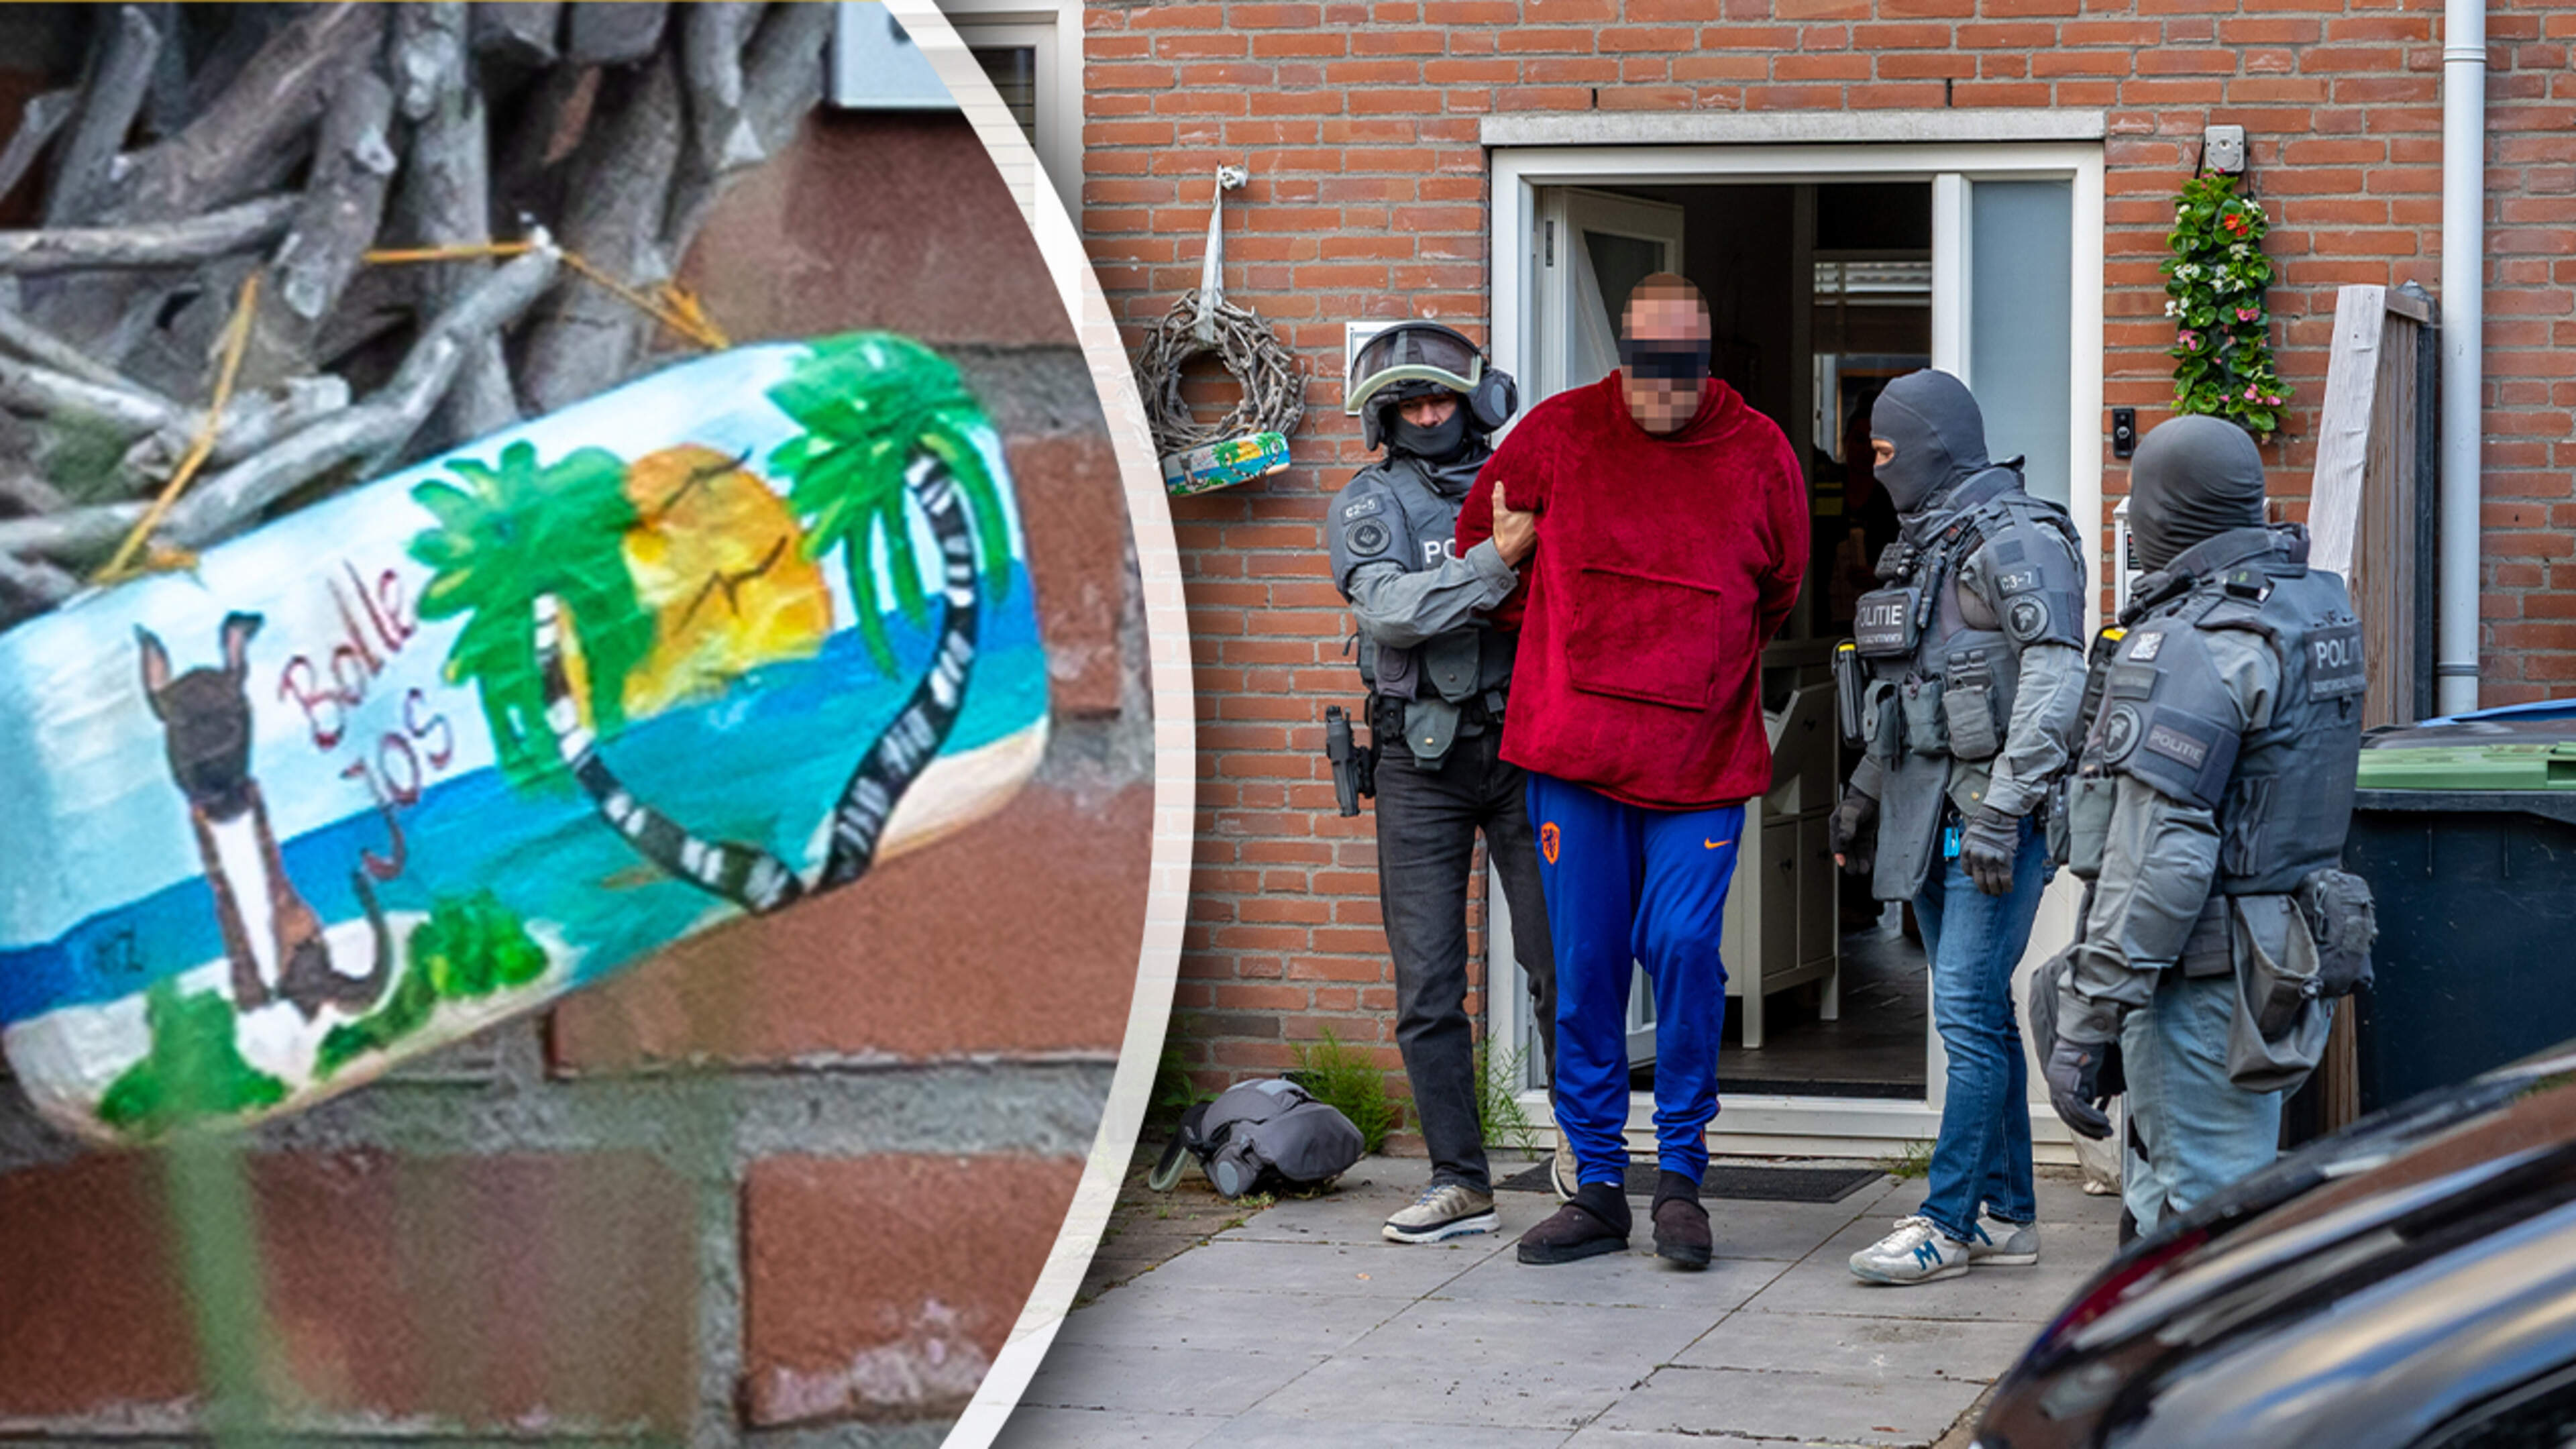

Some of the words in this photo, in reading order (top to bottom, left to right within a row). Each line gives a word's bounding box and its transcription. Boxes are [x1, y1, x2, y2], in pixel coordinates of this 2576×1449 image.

[1346, 499, 1375, 518] C2-5
[2000, 571, 2032, 590] C3-7
[1858, 605, 1902, 627] OLITIE
[278, 558, 417, 750] Bolle
[2150, 730, 2204, 761] POLITIE
